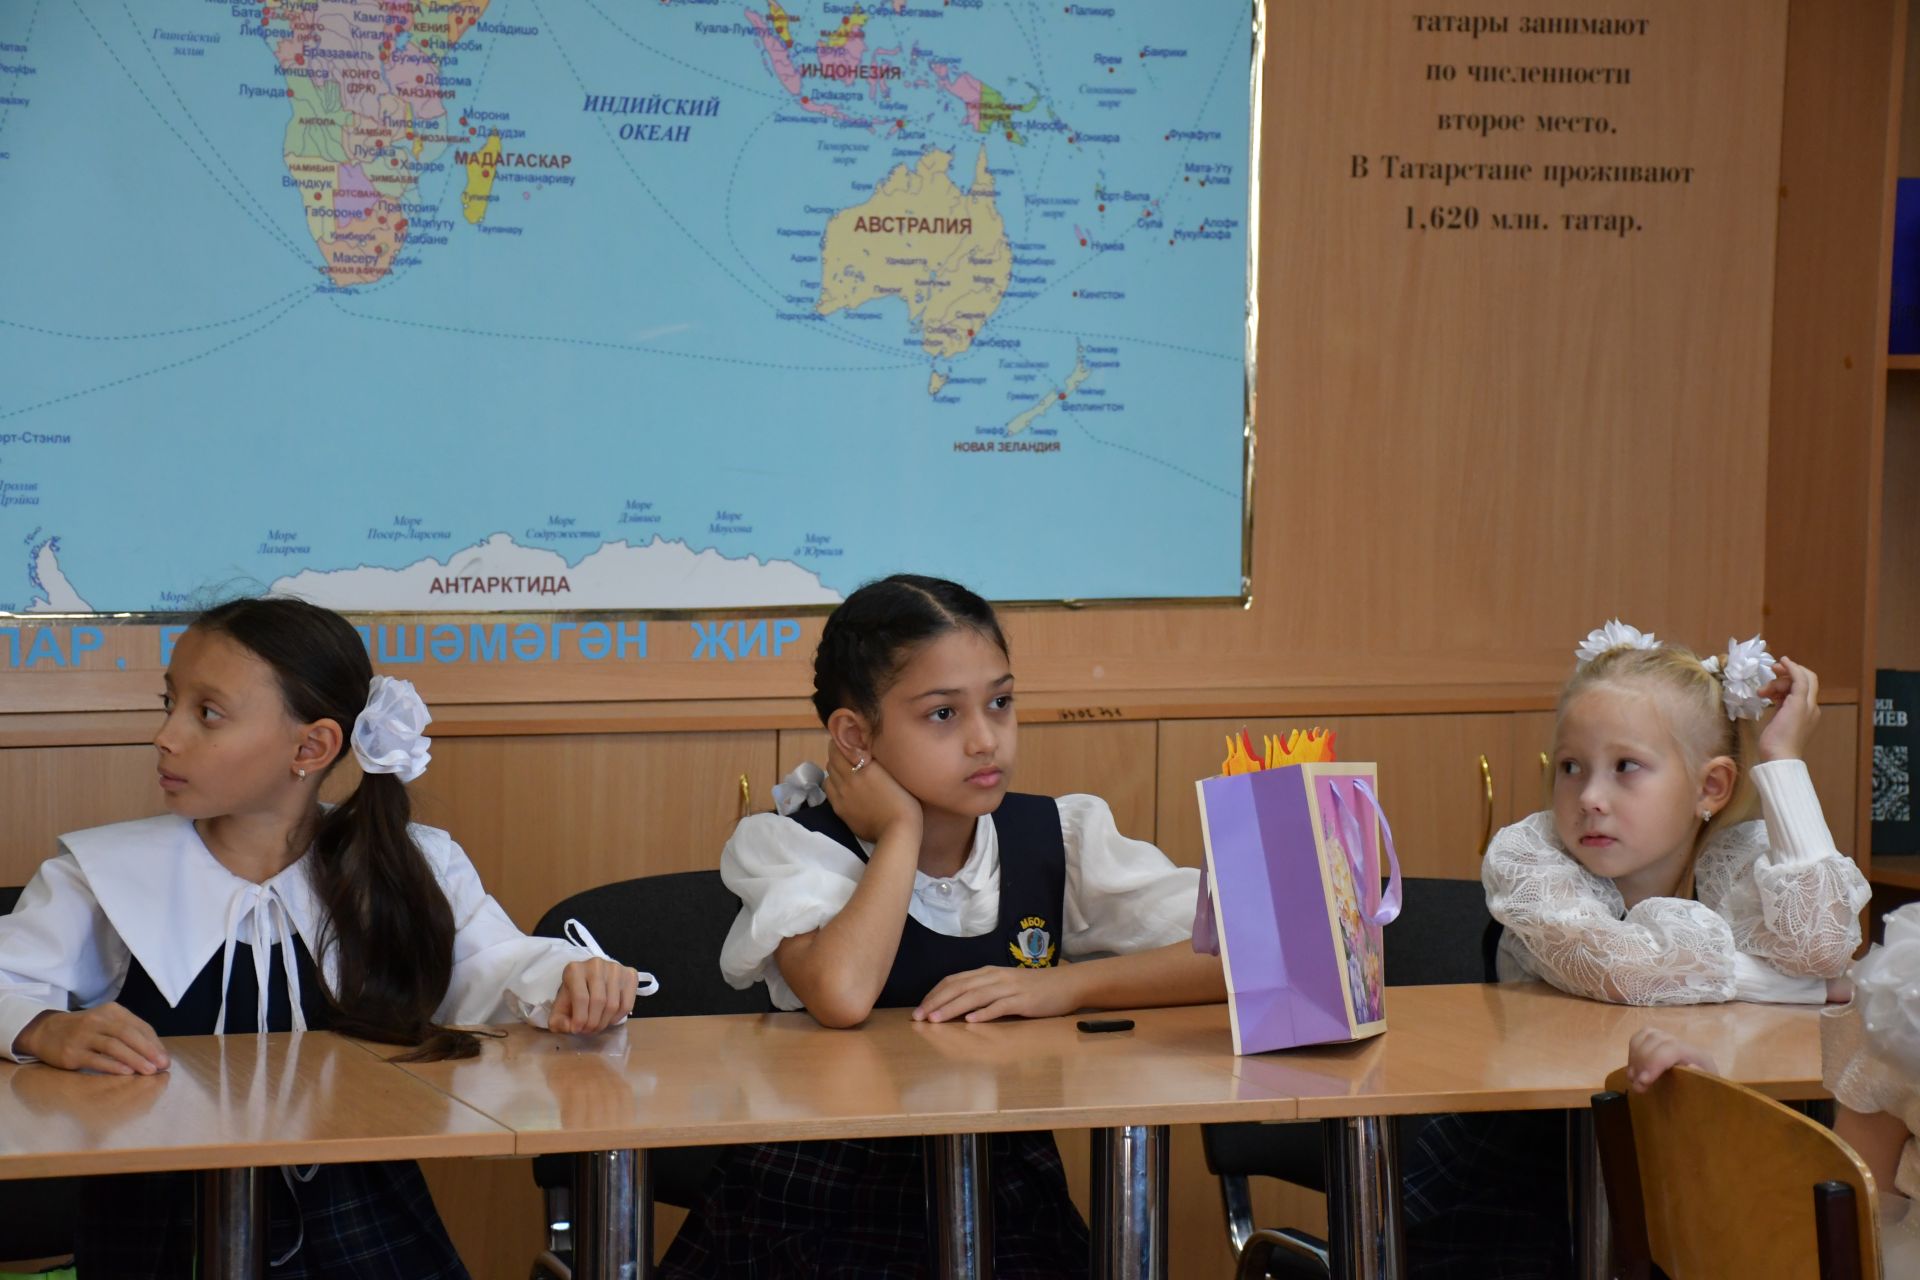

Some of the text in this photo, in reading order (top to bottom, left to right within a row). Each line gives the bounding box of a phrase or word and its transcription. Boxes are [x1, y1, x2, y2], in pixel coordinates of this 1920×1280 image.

[232, 5, 262, 18] Бата
[378, 1, 422, 14] УГАНДА
[353, 11, 407, 25] Кампала
[414, 23, 451, 34] КЕНИЯ
[477, 21, 539, 36] Могадишо
[1412, 13, 1650, 39] татары занимают
[351, 28, 393, 41] Кигали
[428, 36, 483, 52] Найроби
[302, 45, 375, 61] Браззавиль
[391, 51, 459, 67] Бужумбура
[274, 65, 330, 79] Киншаса
[342, 69, 381, 80] КОНГО
[800, 63, 902, 81] ИНДОНЕЗИЯ
[1426, 63, 1632, 85] по численности
[424, 73, 472, 87] Додома
[239, 84, 287, 99] Луанда
[396, 87, 456, 100] ТАНЗАНИЯ
[583, 93, 721, 118] ИНДИЙСКИЙ
[298, 116, 337, 127] АНГОЛА
[463, 107, 511, 122] Морони
[1437, 113, 1618, 137] второе место.
[352, 127, 393, 138] ЗАМБИЯ
[619, 123, 692, 143] ОКЕАН
[353, 144, 397, 159] Лусака
[400, 158, 446, 173] Хараре
[455, 150, 572, 169] МАДАГАСКАР
[288, 163, 336, 174] НАМИБИЯ
[1350, 154, 1696, 188] В Татарстане проживают
[370, 174, 420, 185] ЗИМБАБВЕ
[493, 171, 577, 187] Антананариву
[332, 189, 382, 199] БОТСВАНА
[305, 205, 364, 219] Габороне
[410, 217, 456, 234] Мапуту
[854, 216, 972, 234] АВСТРАЛИЯ
[1404, 206, 1643, 238] 1,620 млн. татар.
[394, 232, 449, 247] Мбабане
[332, 252, 380, 267] Масеру
[1079, 288, 1126, 300] Кингстон
[1061, 400, 1125, 413] Веллингтон
[954, 441, 1062, 454] НОВАЯ ЗЕЛАНДИЯ
[625, 499, 653, 512] Море
[393, 515, 423, 528] Море
[548, 515, 577, 528] Море
[716, 510, 743, 523] Море
[267, 529, 297, 543] Море
[805, 532, 832, 546] Море
[257, 543, 311, 556] Лазарева
[429, 575, 571, 596] АНТАРКТИДА
[1020, 916, 1047, 930] МБОУ
